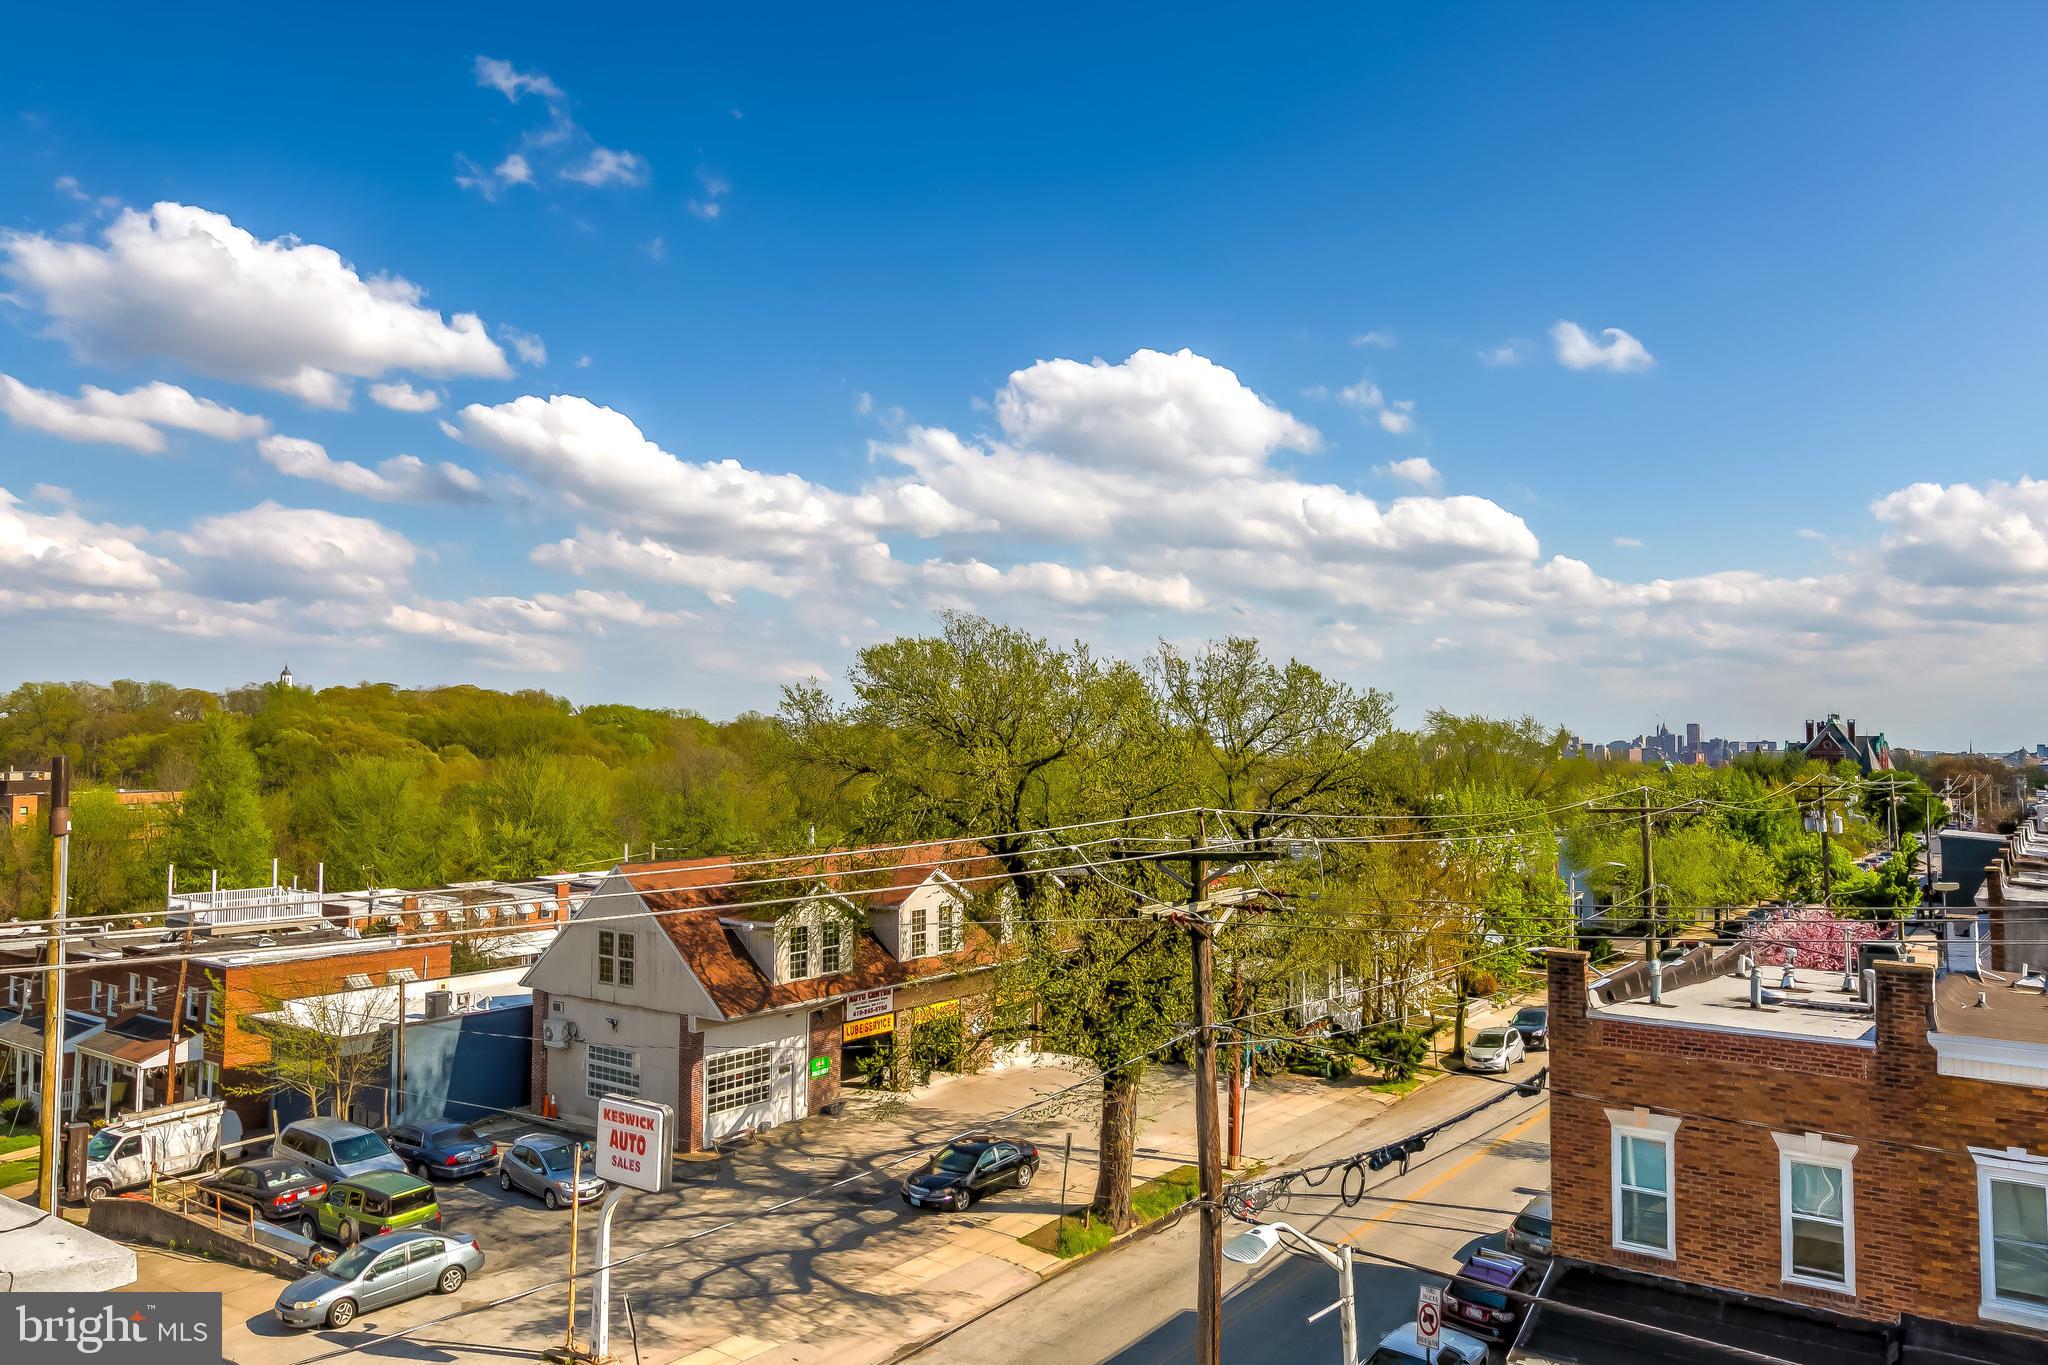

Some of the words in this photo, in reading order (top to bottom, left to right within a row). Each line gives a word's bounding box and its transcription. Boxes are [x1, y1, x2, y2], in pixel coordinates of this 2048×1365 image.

[846, 1023, 864, 1037] LUBE
[864, 1017, 891, 1033] SERVICE
[603, 1108, 655, 1131] KESWICK
[609, 1128, 647, 1156] AUTO
[611, 1155, 641, 1173] SALES
